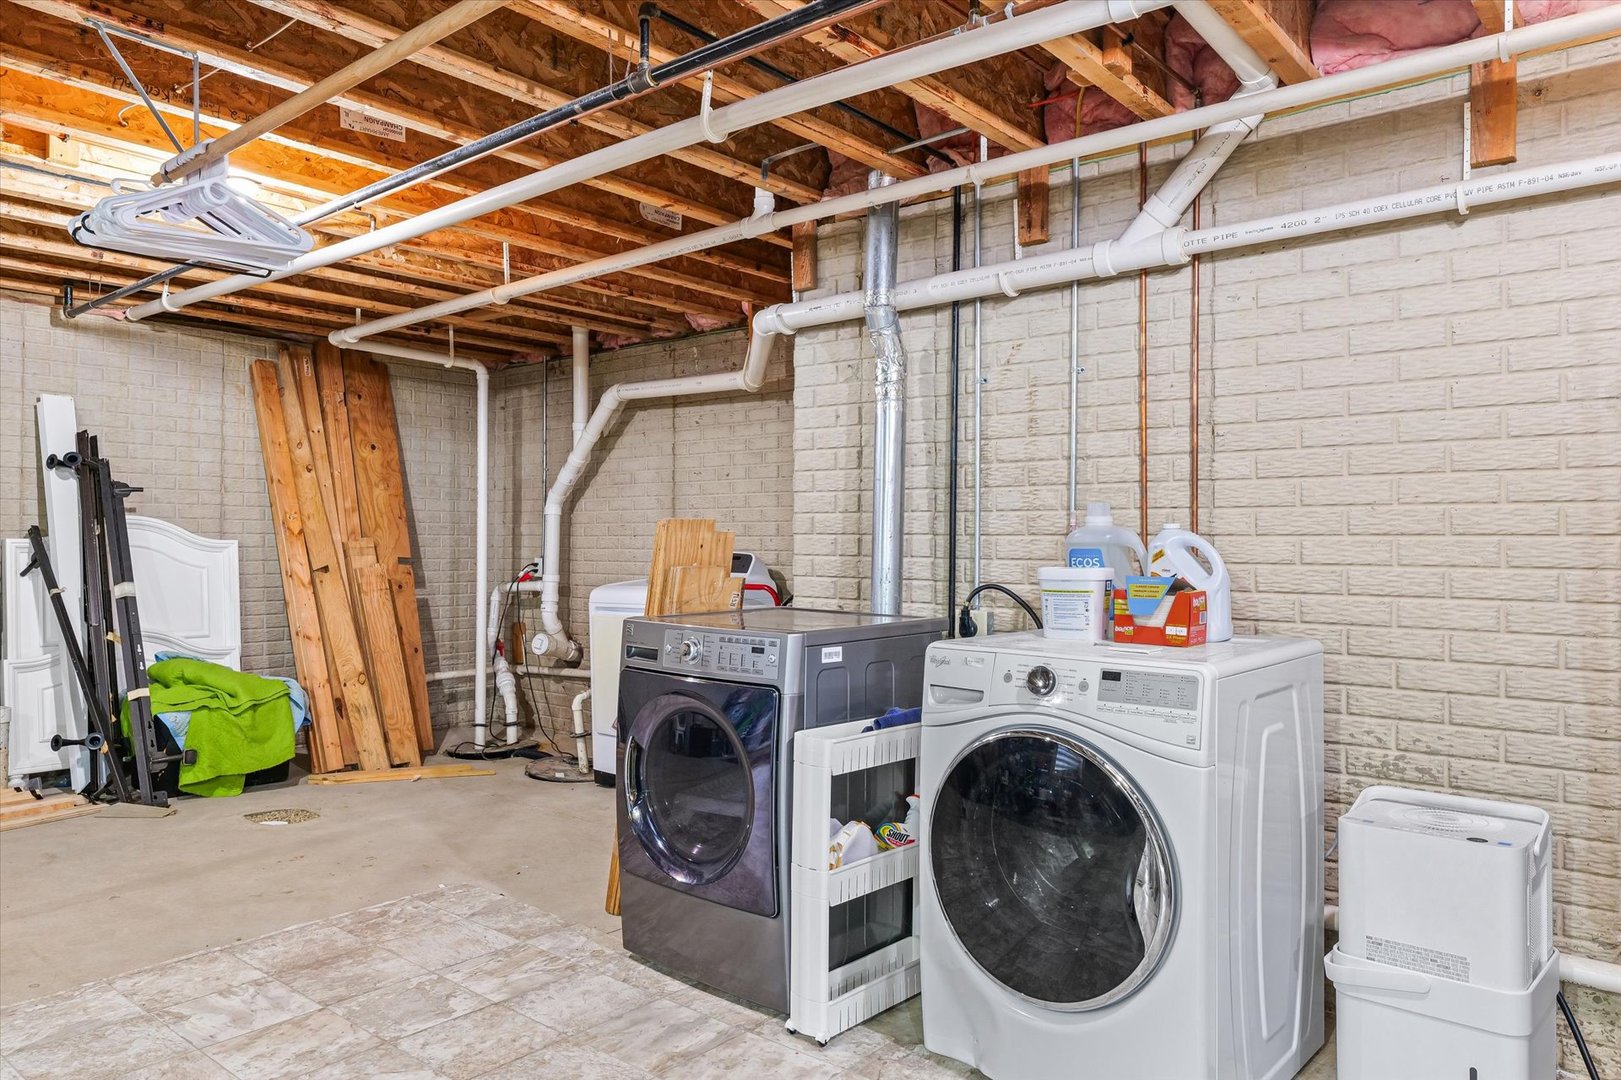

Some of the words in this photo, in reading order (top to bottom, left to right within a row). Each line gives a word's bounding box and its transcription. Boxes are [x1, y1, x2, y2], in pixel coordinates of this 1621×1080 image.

[1213, 232, 1239, 242] PIPE
[1280, 219, 1308, 230] 4200
[1349, 209, 1360, 218] SCH
[1362, 207, 1371, 215] 40
[1373, 204, 1389, 213] COEX
[1391, 198, 1423, 210] CELLULAR
[1426, 195, 1442, 204] CORE
[1477, 185, 1494, 194] PIPE
[1497, 181, 1516, 190] ASTM
[1071, 557, 1100, 568] ECOS
[886, 829, 911, 843] SHOUT
